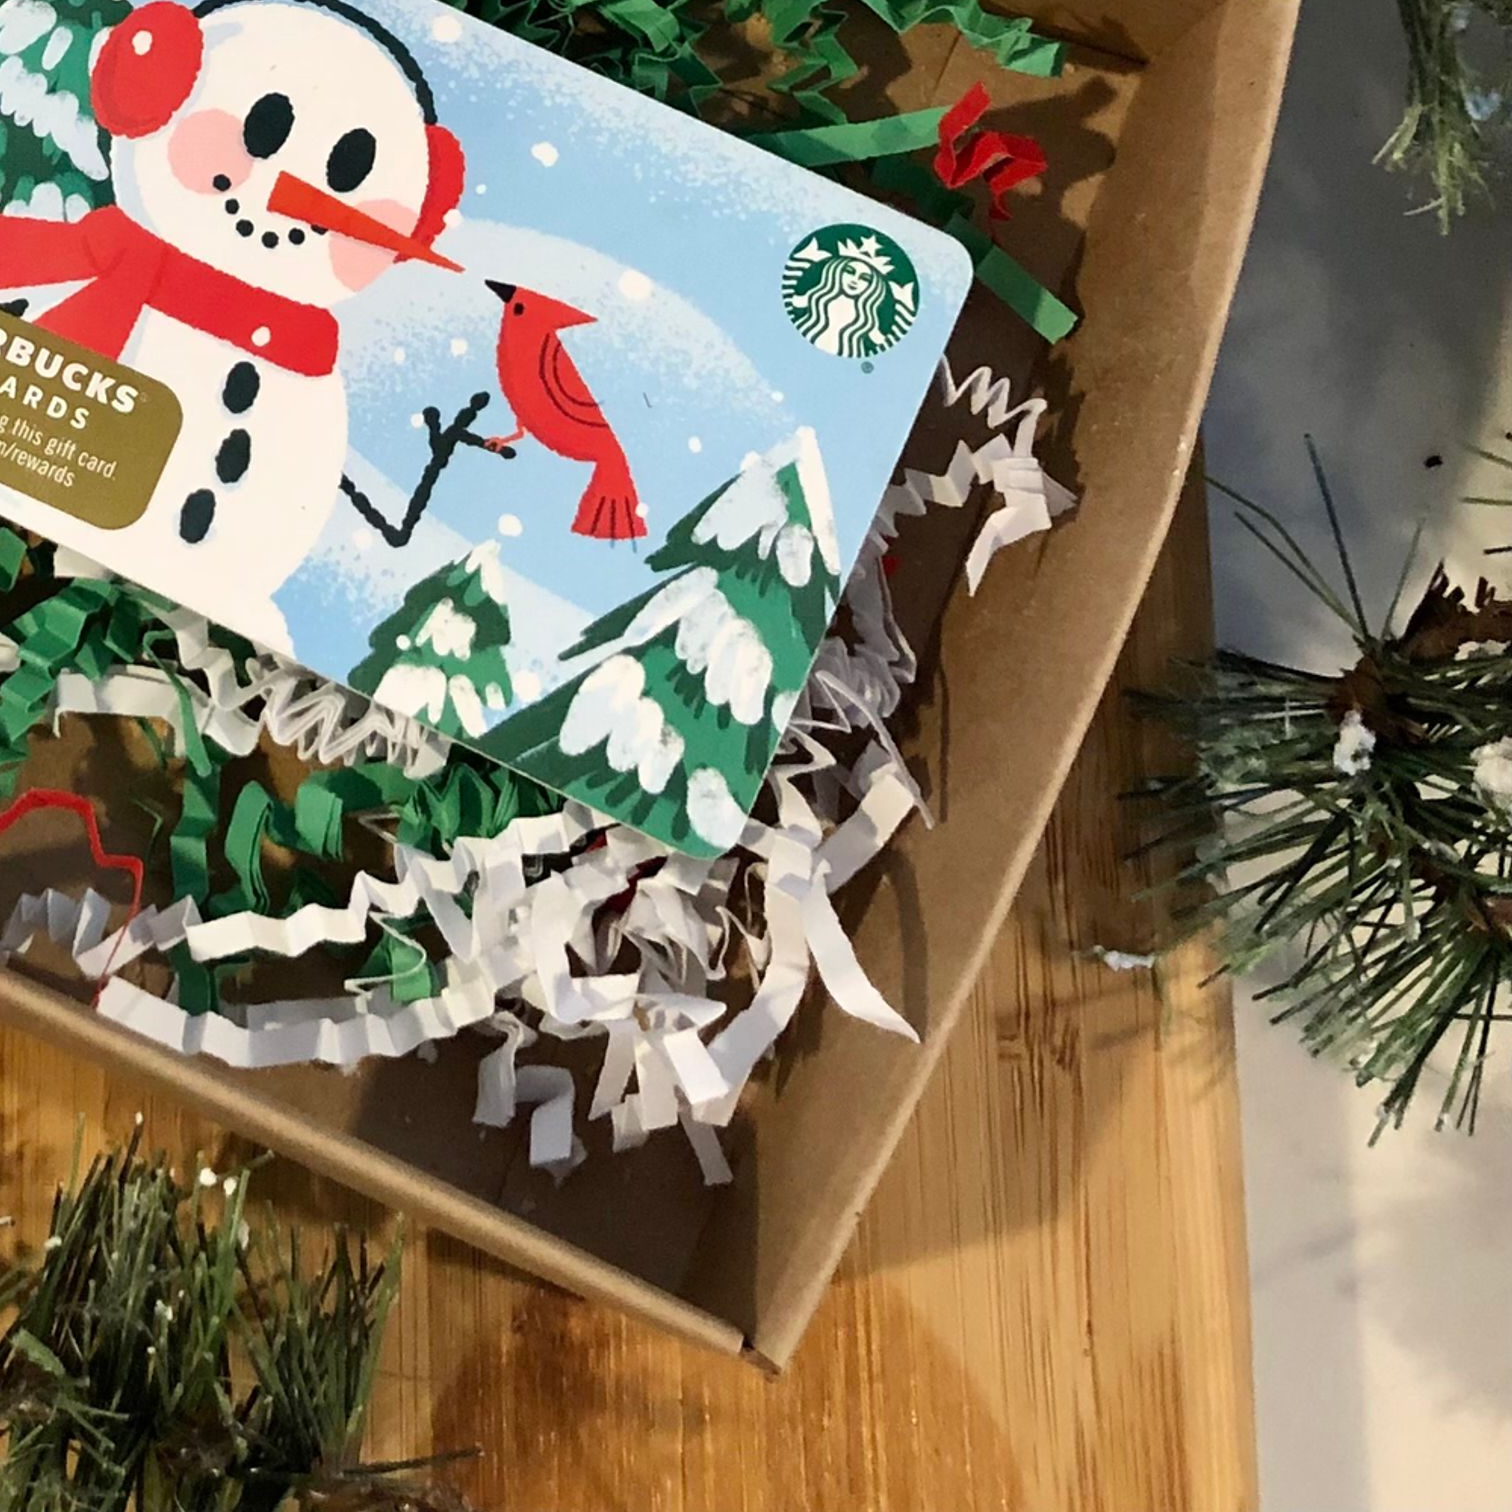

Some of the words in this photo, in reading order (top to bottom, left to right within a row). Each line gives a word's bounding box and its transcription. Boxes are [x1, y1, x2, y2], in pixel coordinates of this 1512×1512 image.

[13, 417, 43, 445] this
[44, 437, 77, 462] gift
[77, 449, 117, 481] card.
